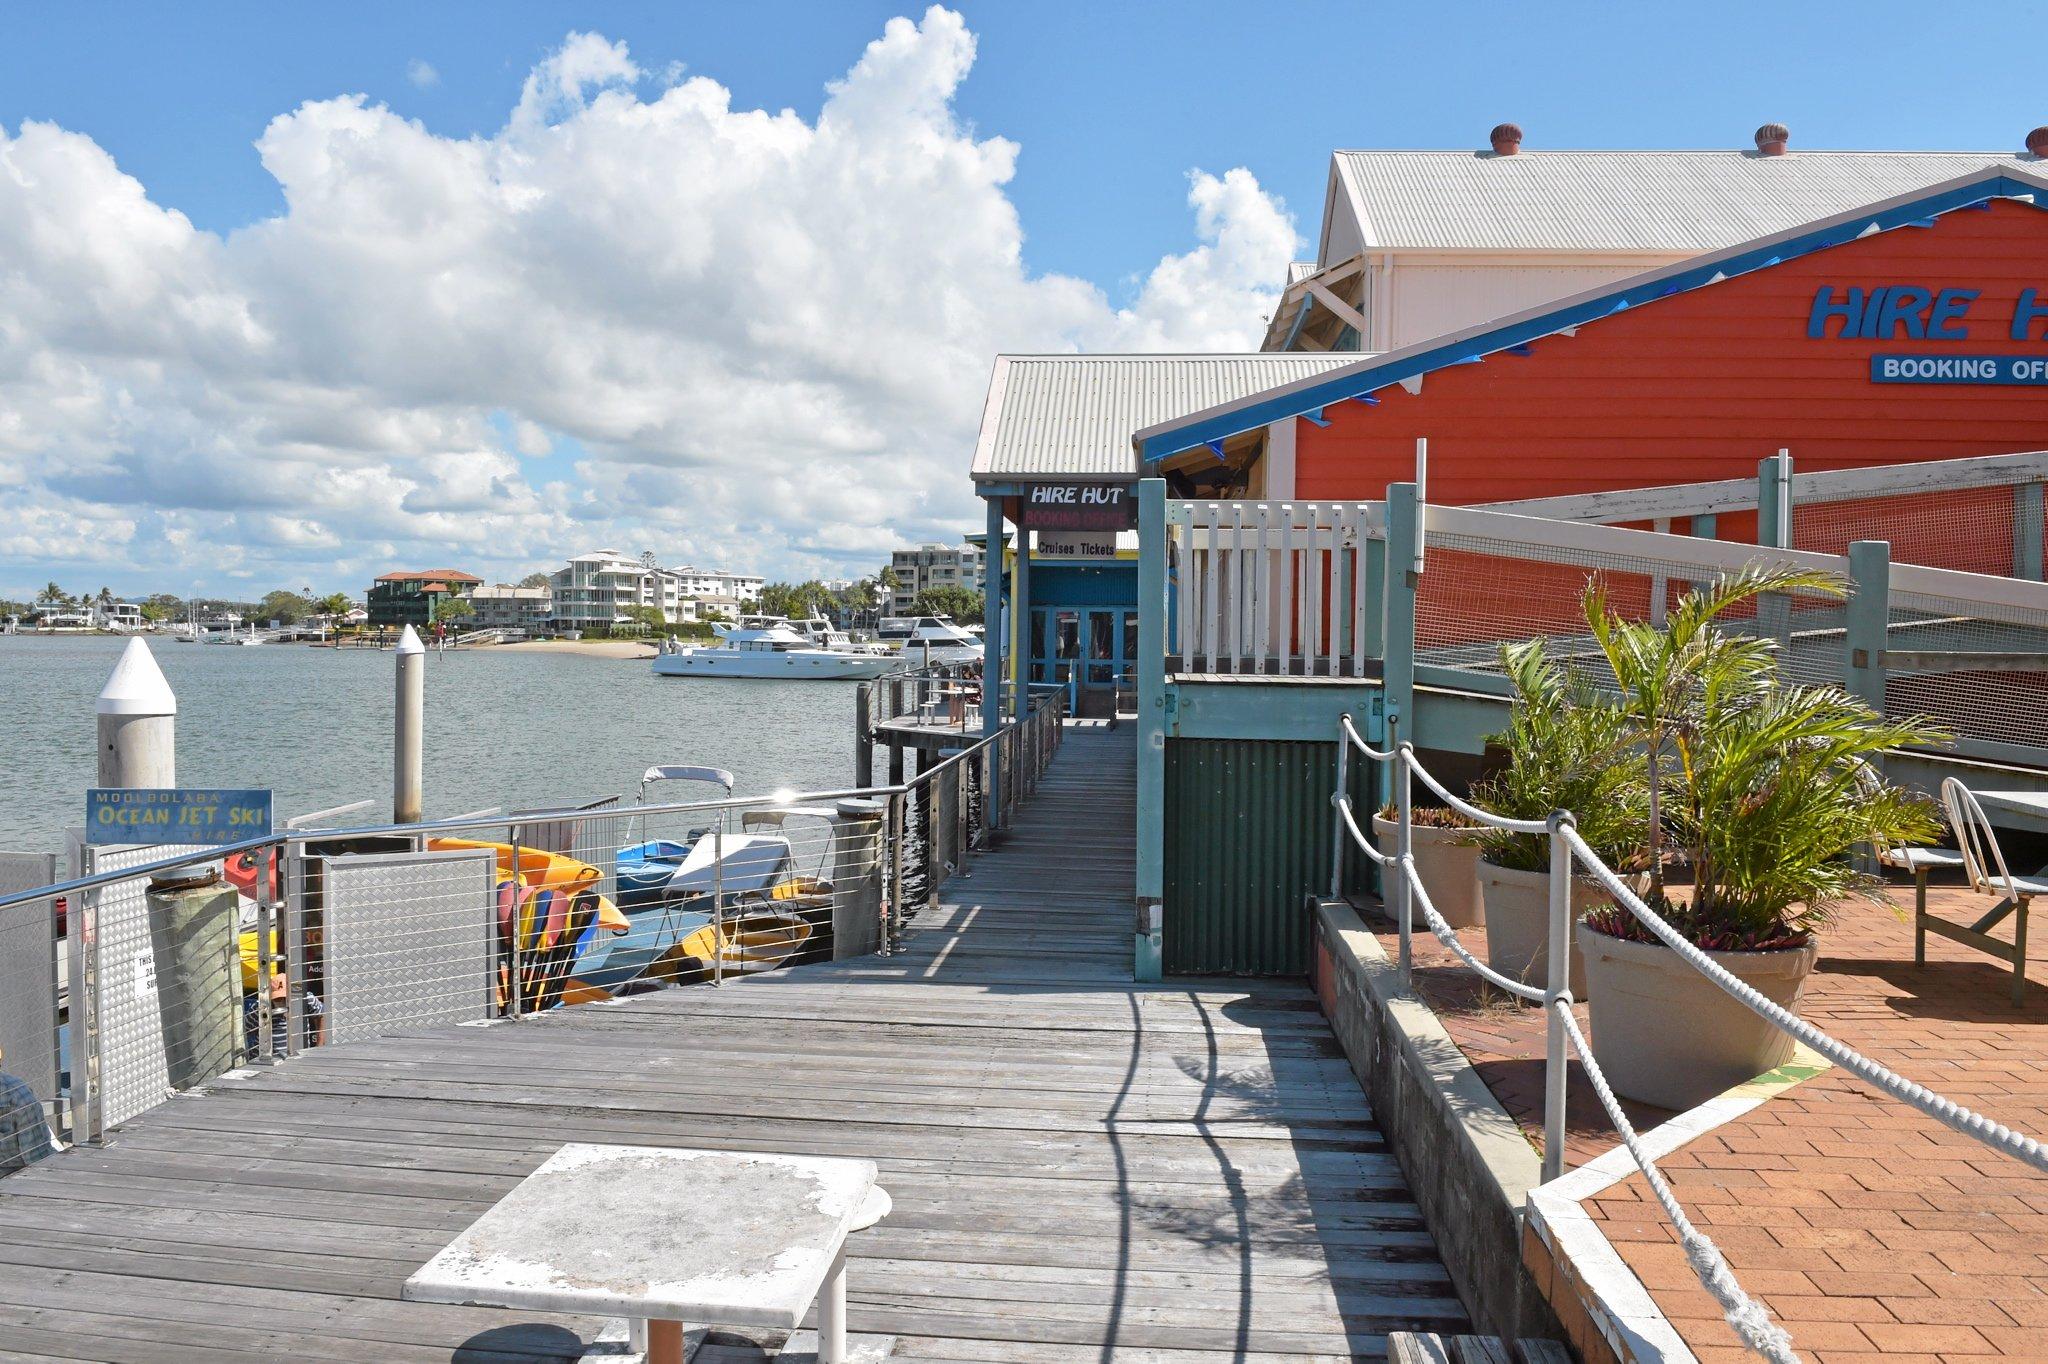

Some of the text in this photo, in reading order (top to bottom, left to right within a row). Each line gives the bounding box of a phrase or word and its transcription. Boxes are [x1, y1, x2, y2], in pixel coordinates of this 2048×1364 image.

[1807, 285, 1982, 340] HIRE
[1884, 358, 1997, 378] BOOKING
[1031, 486, 1124, 504] HIRE HUT
[1024, 510, 1080, 527] BOOKING
[1038, 541, 1115, 556] Cruises Tickets
[98, 804, 264, 826] OCEAN JET SKI
